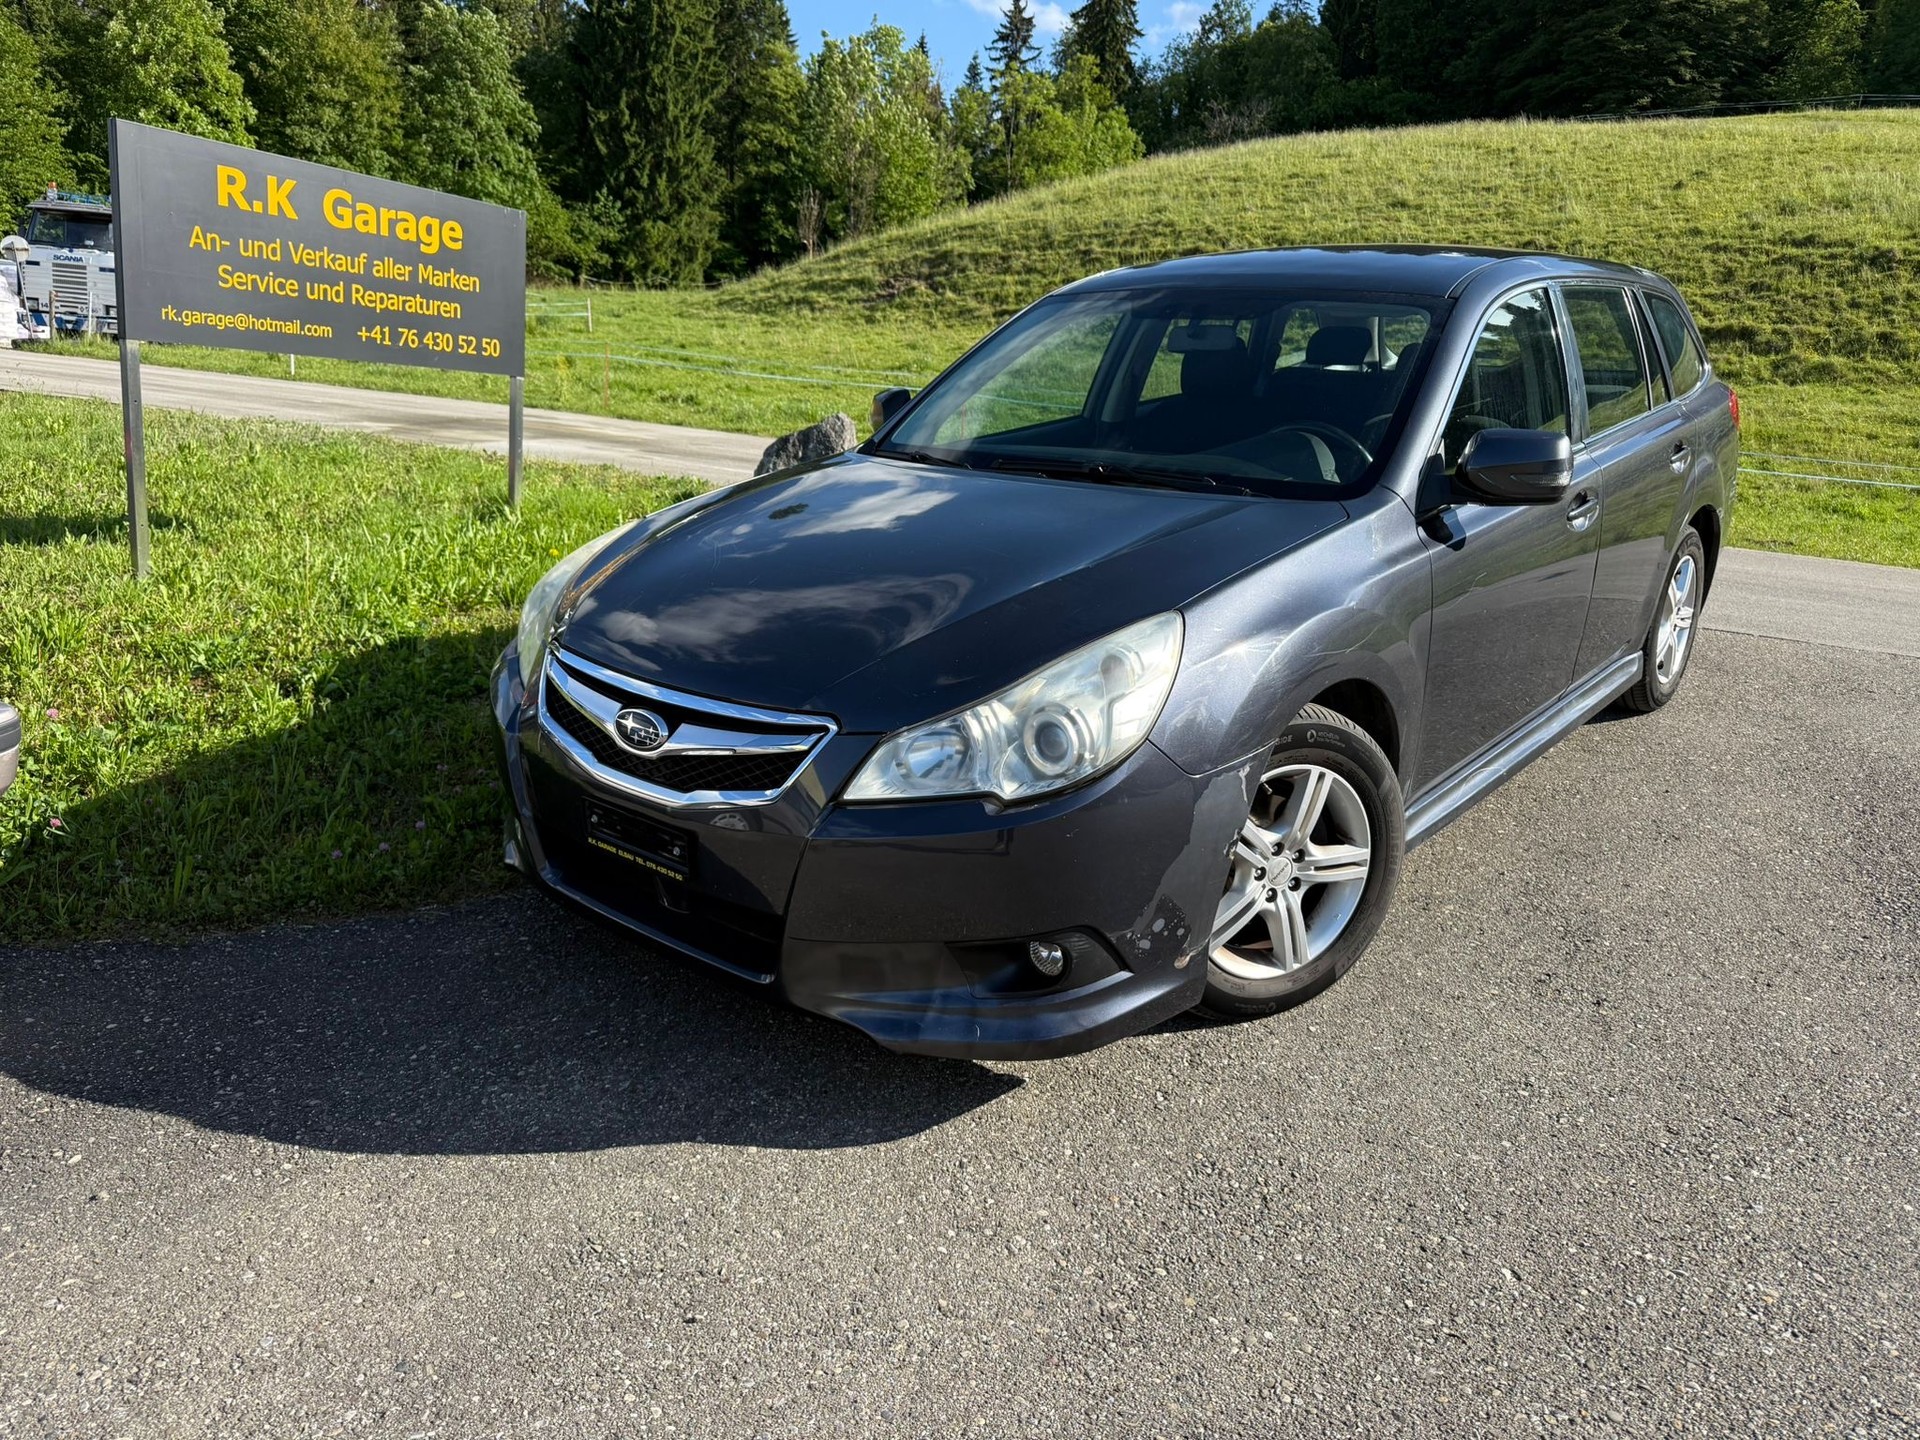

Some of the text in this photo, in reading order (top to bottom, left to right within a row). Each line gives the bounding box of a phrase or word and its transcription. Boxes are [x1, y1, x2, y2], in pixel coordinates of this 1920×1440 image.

[216, 164, 465, 256] R.K Garage
[53, 254, 84, 263] SCANIA
[189, 225, 481, 293] An- und Verkauf aller Marken
[218, 264, 462, 320] Service und Reparaturen
[160, 304, 334, 340] rk.garage@hotmail.com
[357, 325, 502, 359] +41 76 430 52 50
[597, 841, 617, 854] GARAGE
